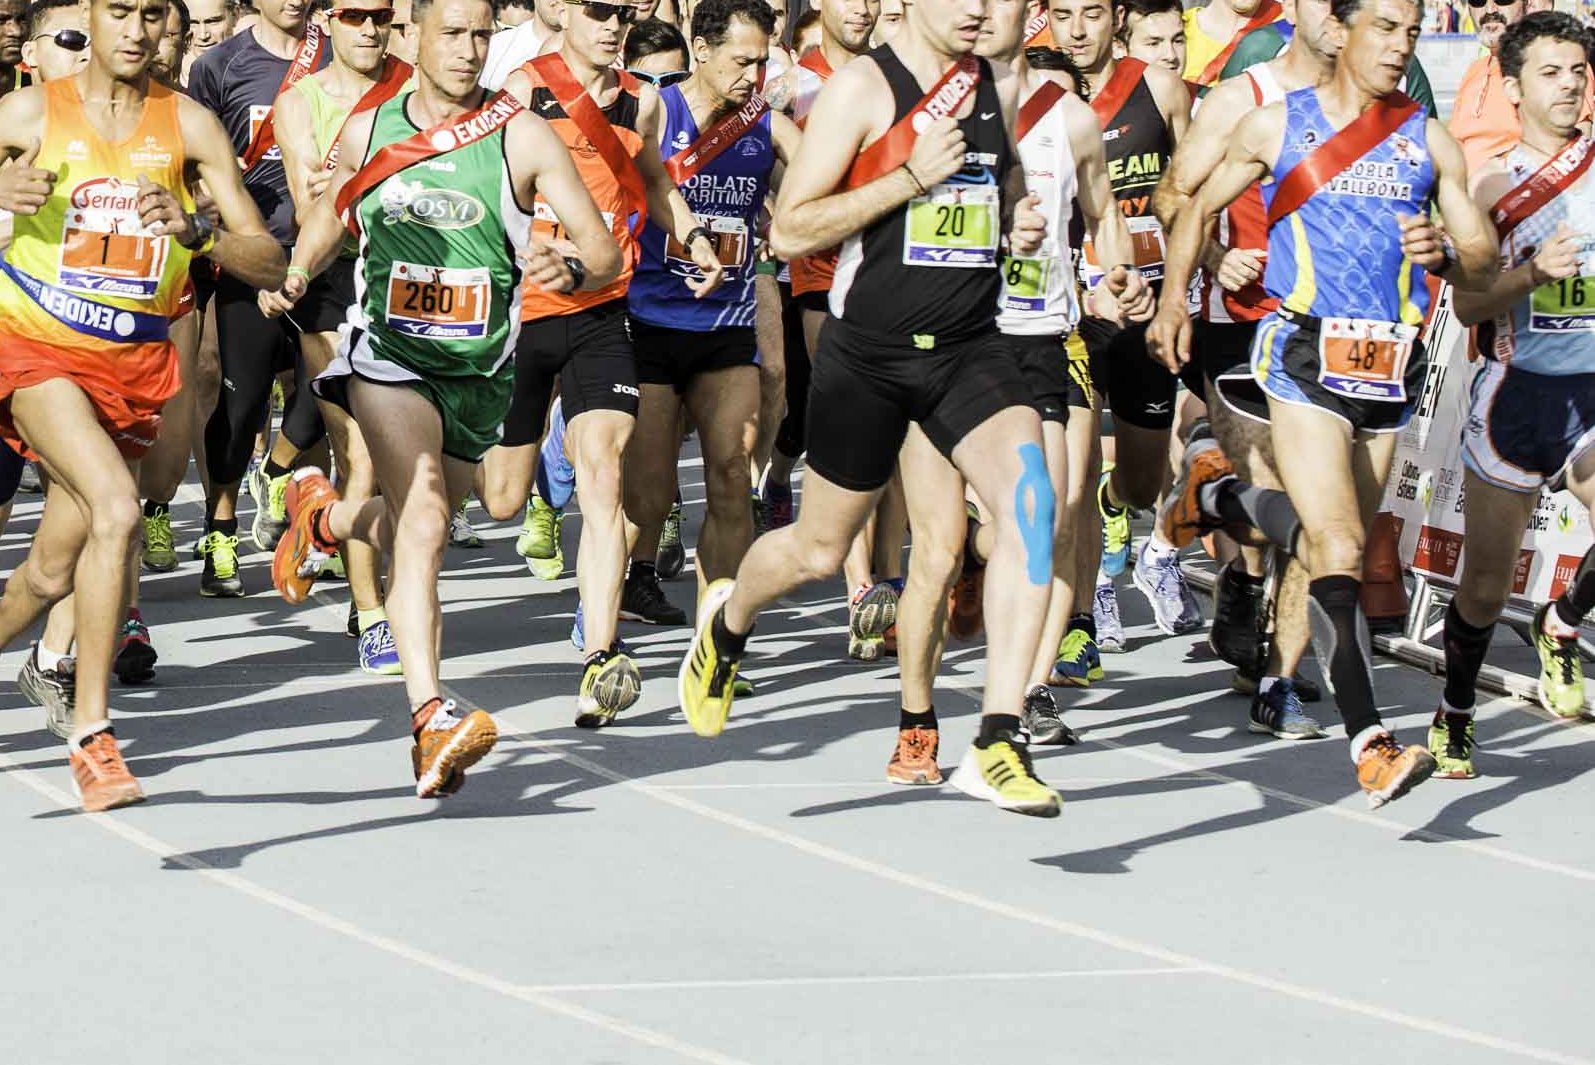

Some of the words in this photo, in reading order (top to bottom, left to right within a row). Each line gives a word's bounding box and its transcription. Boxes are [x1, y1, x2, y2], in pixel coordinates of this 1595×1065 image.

[926, 70, 975, 121] EKIDEN
[453, 99, 516, 145] EKIDEN
[1108, 152, 1161, 182] EAM
[73, 188, 139, 211] Serran
[1329, 179, 1410, 200] VALLBONA
[935, 206, 965, 237] 20
[99, 234, 111, 265] 1
[38, 285, 115, 331] EKIDEN
[403, 281, 453, 314] 260
[1558, 278, 1586, 308] 16
[1347, 340, 1376, 371] 48
